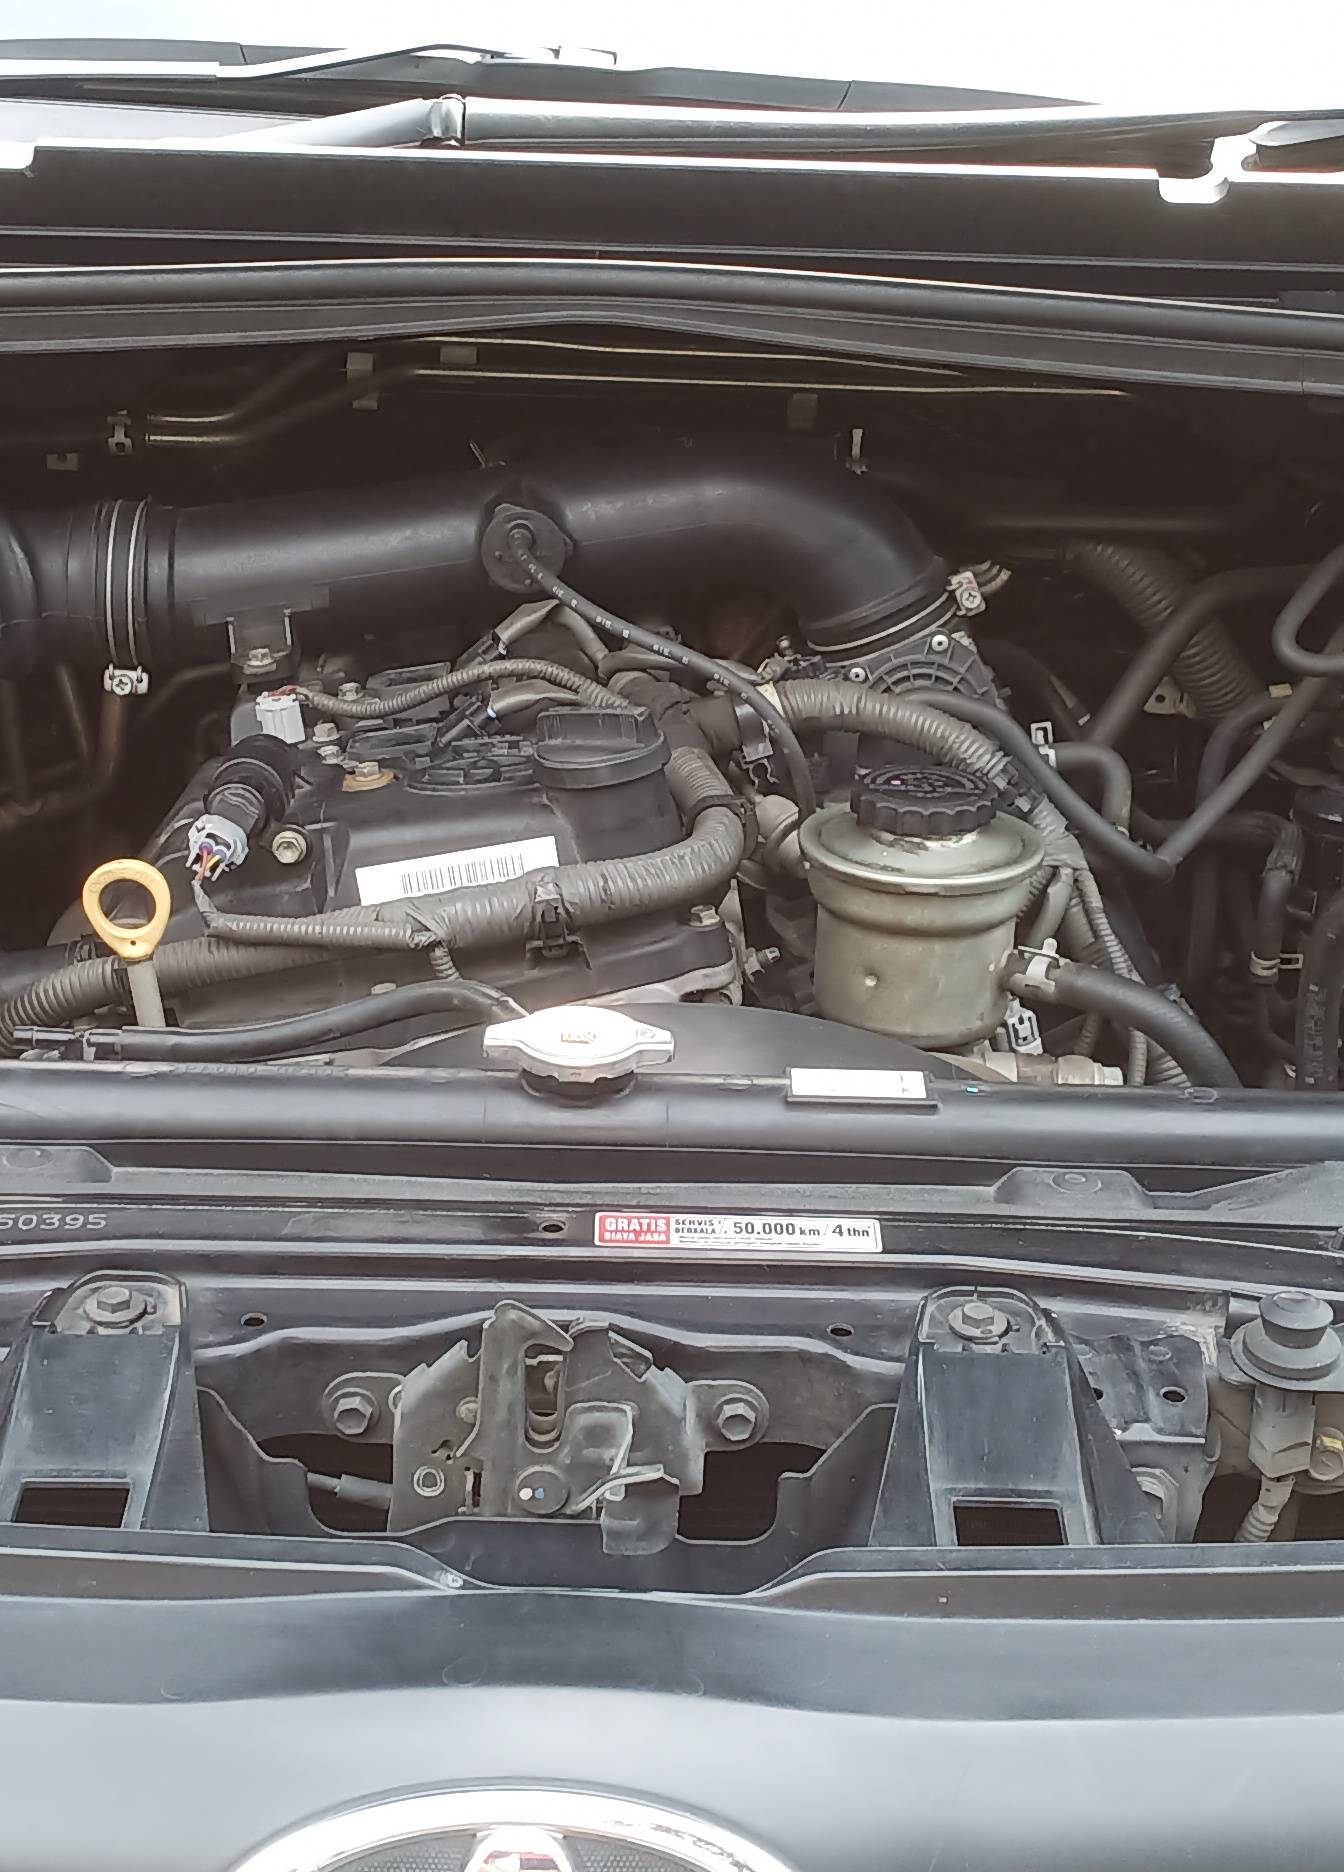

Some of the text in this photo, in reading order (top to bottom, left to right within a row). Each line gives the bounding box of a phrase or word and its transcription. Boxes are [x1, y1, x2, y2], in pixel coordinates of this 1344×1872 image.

[604, 1218, 668, 1231] GRATIS
[674, 1218, 715, 1227] SERVIS
[733, 1221, 796, 1236] 50.000
[798, 1226, 822, 1237] km
[831, 1224, 845, 1237] 4
[847, 1227, 871, 1238] thn
[603, 1231, 636, 1241] BIAYA
[638, 1232, 667, 1242] JASA
